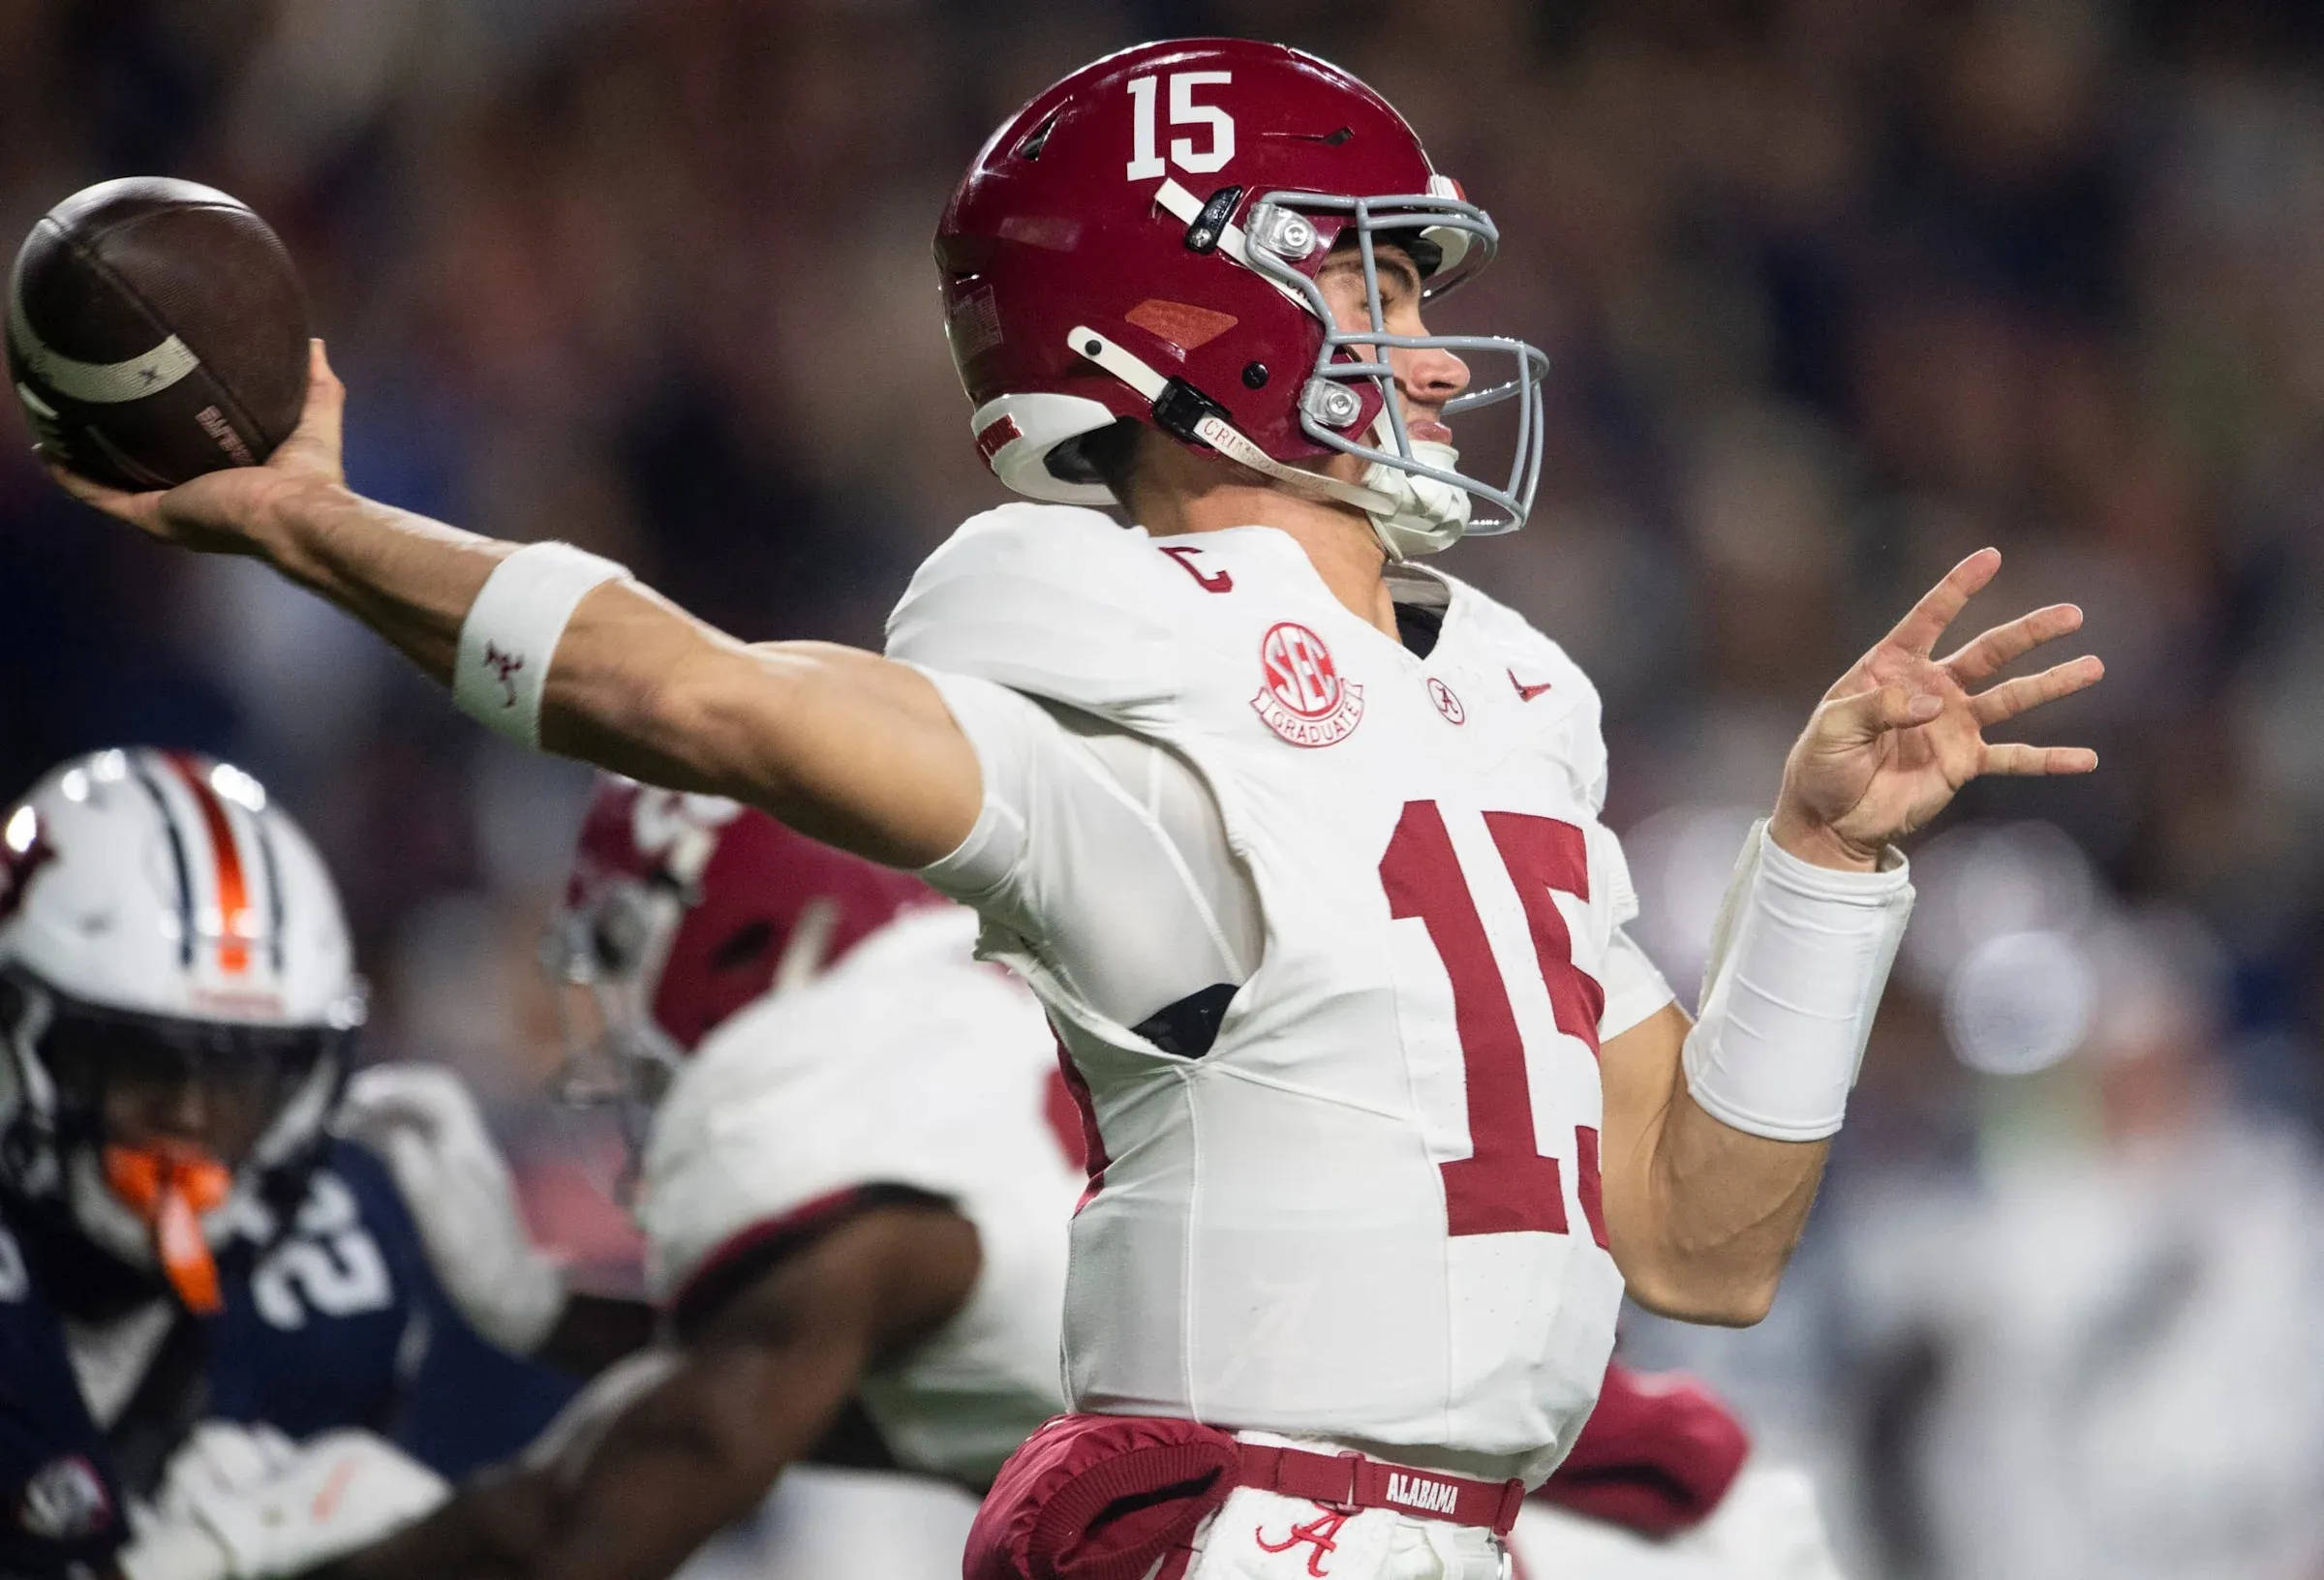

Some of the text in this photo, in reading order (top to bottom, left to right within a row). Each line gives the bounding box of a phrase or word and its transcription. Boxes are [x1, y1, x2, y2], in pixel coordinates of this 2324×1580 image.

[1126, 71, 1236, 182] 15
[1264, 624, 1339, 713] SEC
[1271, 700, 1361, 744] GRADUATE
[1378, 800, 1609, 1249] 15
[1386, 1473, 1459, 1515] ALABAMA
